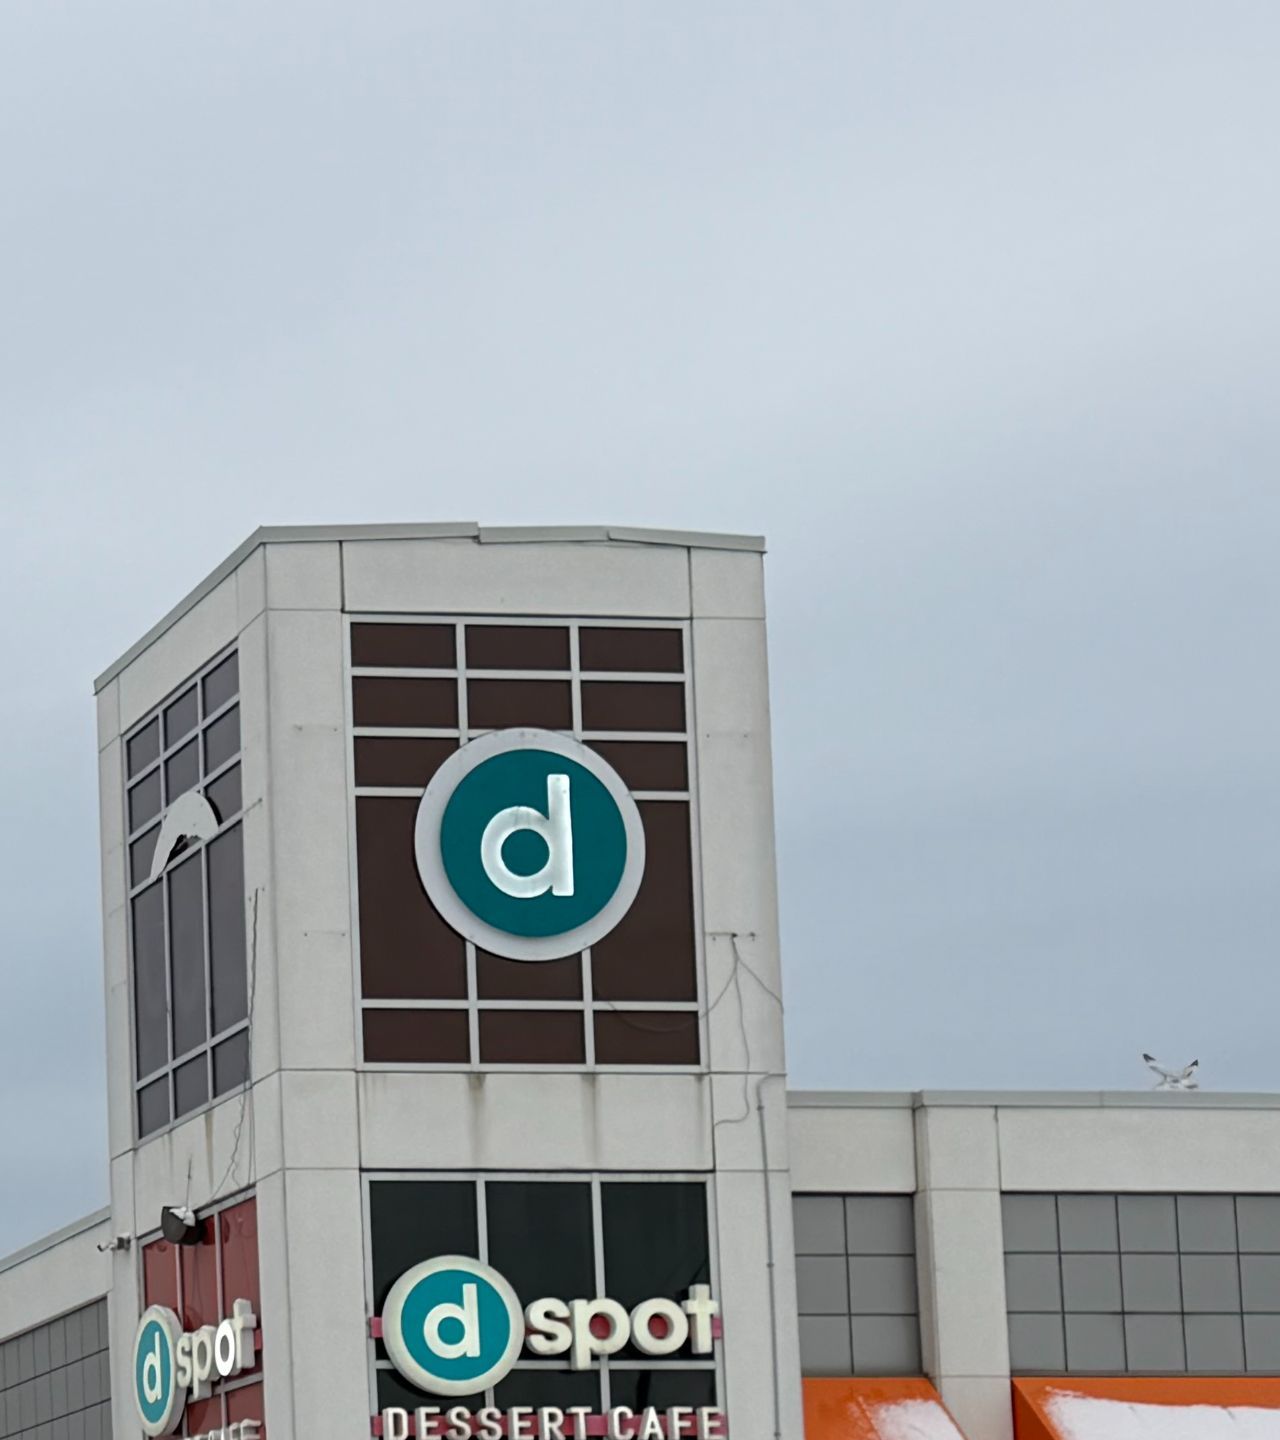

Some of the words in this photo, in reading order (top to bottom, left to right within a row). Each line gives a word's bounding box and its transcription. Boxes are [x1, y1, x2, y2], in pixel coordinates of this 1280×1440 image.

[480, 773, 575, 898] d
[176, 1298, 257, 1401] spot
[525, 1283, 719, 1371] spot
